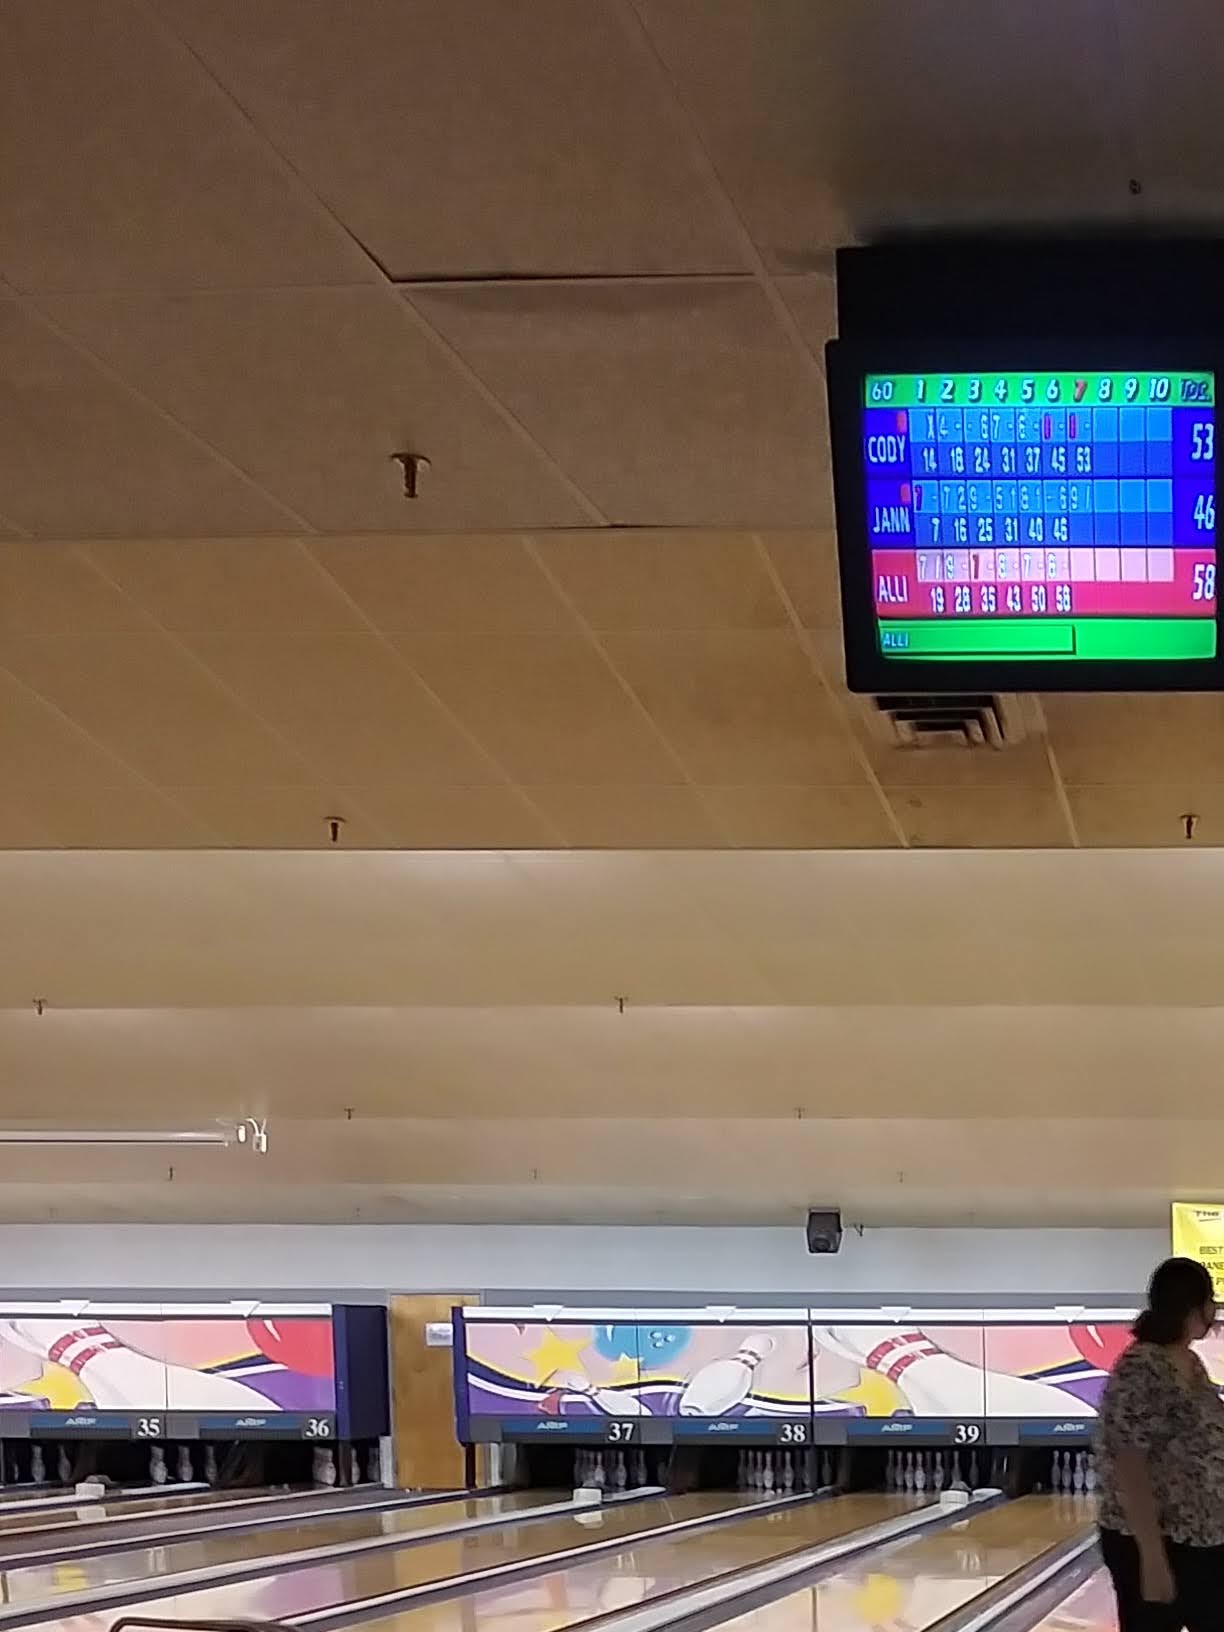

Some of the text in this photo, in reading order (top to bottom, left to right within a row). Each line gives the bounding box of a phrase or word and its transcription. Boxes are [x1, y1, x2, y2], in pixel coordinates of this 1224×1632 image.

[872, 382, 893, 400] 60
[917, 379, 924, 399] 1
[941, 379, 953, 400] 2
[968, 379, 980, 400] 3
[994, 379, 1006, 400] 4
[1021, 379, 1033, 400] 5
[1046, 379, 1059, 399] 6
[1074, 380, 1086, 400] 7
[1099, 378, 1111, 399] 8
[1125, 378, 1138, 399] 9
[1149, 378, 1169, 399] 10
[868, 435, 906, 463] CODY
[1192, 423, 1215, 460] 53
[923, 447, 937, 473] 14
[975, 447, 990, 473] 24
[1001, 447, 1015, 473] 31
[1026, 447, 1040, 473] 37
[1051, 447, 1066, 473] 45
[1077, 447, 1091, 473] 53
[873, 507, 910, 533] JANN
[1194, 495, 1215, 530] 46
[954, 517, 967, 542] 16
[978, 517, 993, 542] 25
[1005, 517, 1018, 542] 31
[1029, 517, 1043, 542] 40
[878, 576, 908, 603] ALLI
[1192, 564, 1216, 600] 58
[931, 584, 1071, 613] 19 28 35 43 50 58
[883, 632, 909, 647] ALLI
[1199, 1245, 1224, 1255] BEST
[137, 1418, 161, 1437] 35
[306, 1418, 330, 1437] 36
[609, 1422, 634, 1442] 37
[781, 1423, 806, 1443] 38
[954, 1424, 979, 1444] 39
